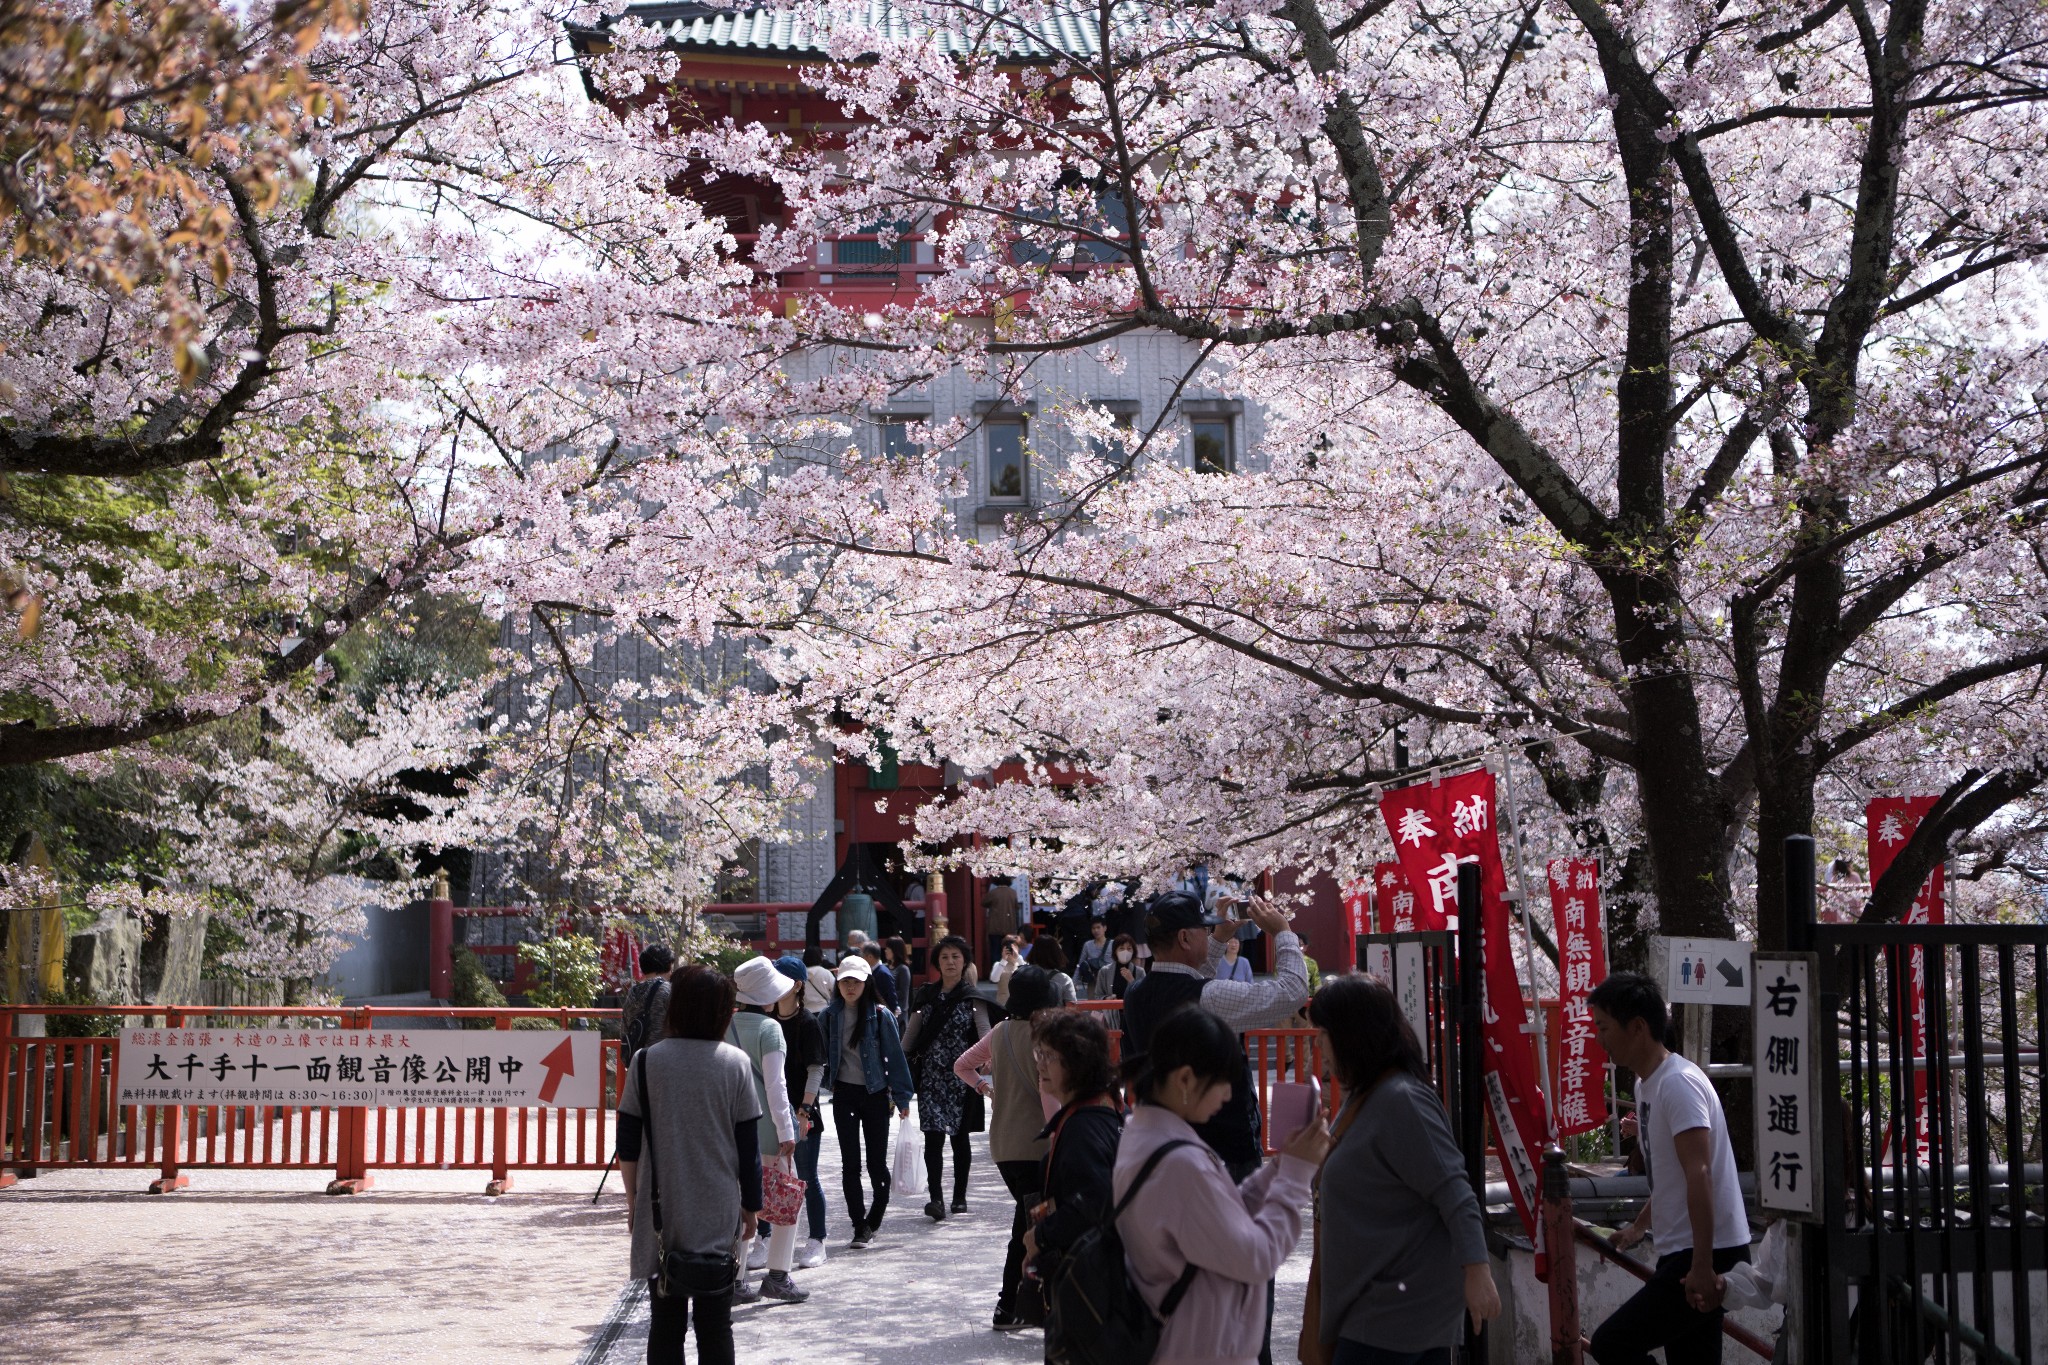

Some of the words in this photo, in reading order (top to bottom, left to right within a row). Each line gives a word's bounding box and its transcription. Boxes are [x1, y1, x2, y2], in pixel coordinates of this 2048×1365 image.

[1397, 794, 1488, 849] 奉納
[1557, 868, 1594, 893] 奉納
[1560, 896, 1597, 1129] 南無観世音菩薩
[131, 1032, 412, 1048] 総漆金箔張・木造の立像では日本最大
[144, 1052, 524, 1085] 大千手十一面観音像公開中
[1765, 976, 1803, 1193] 右側通行
